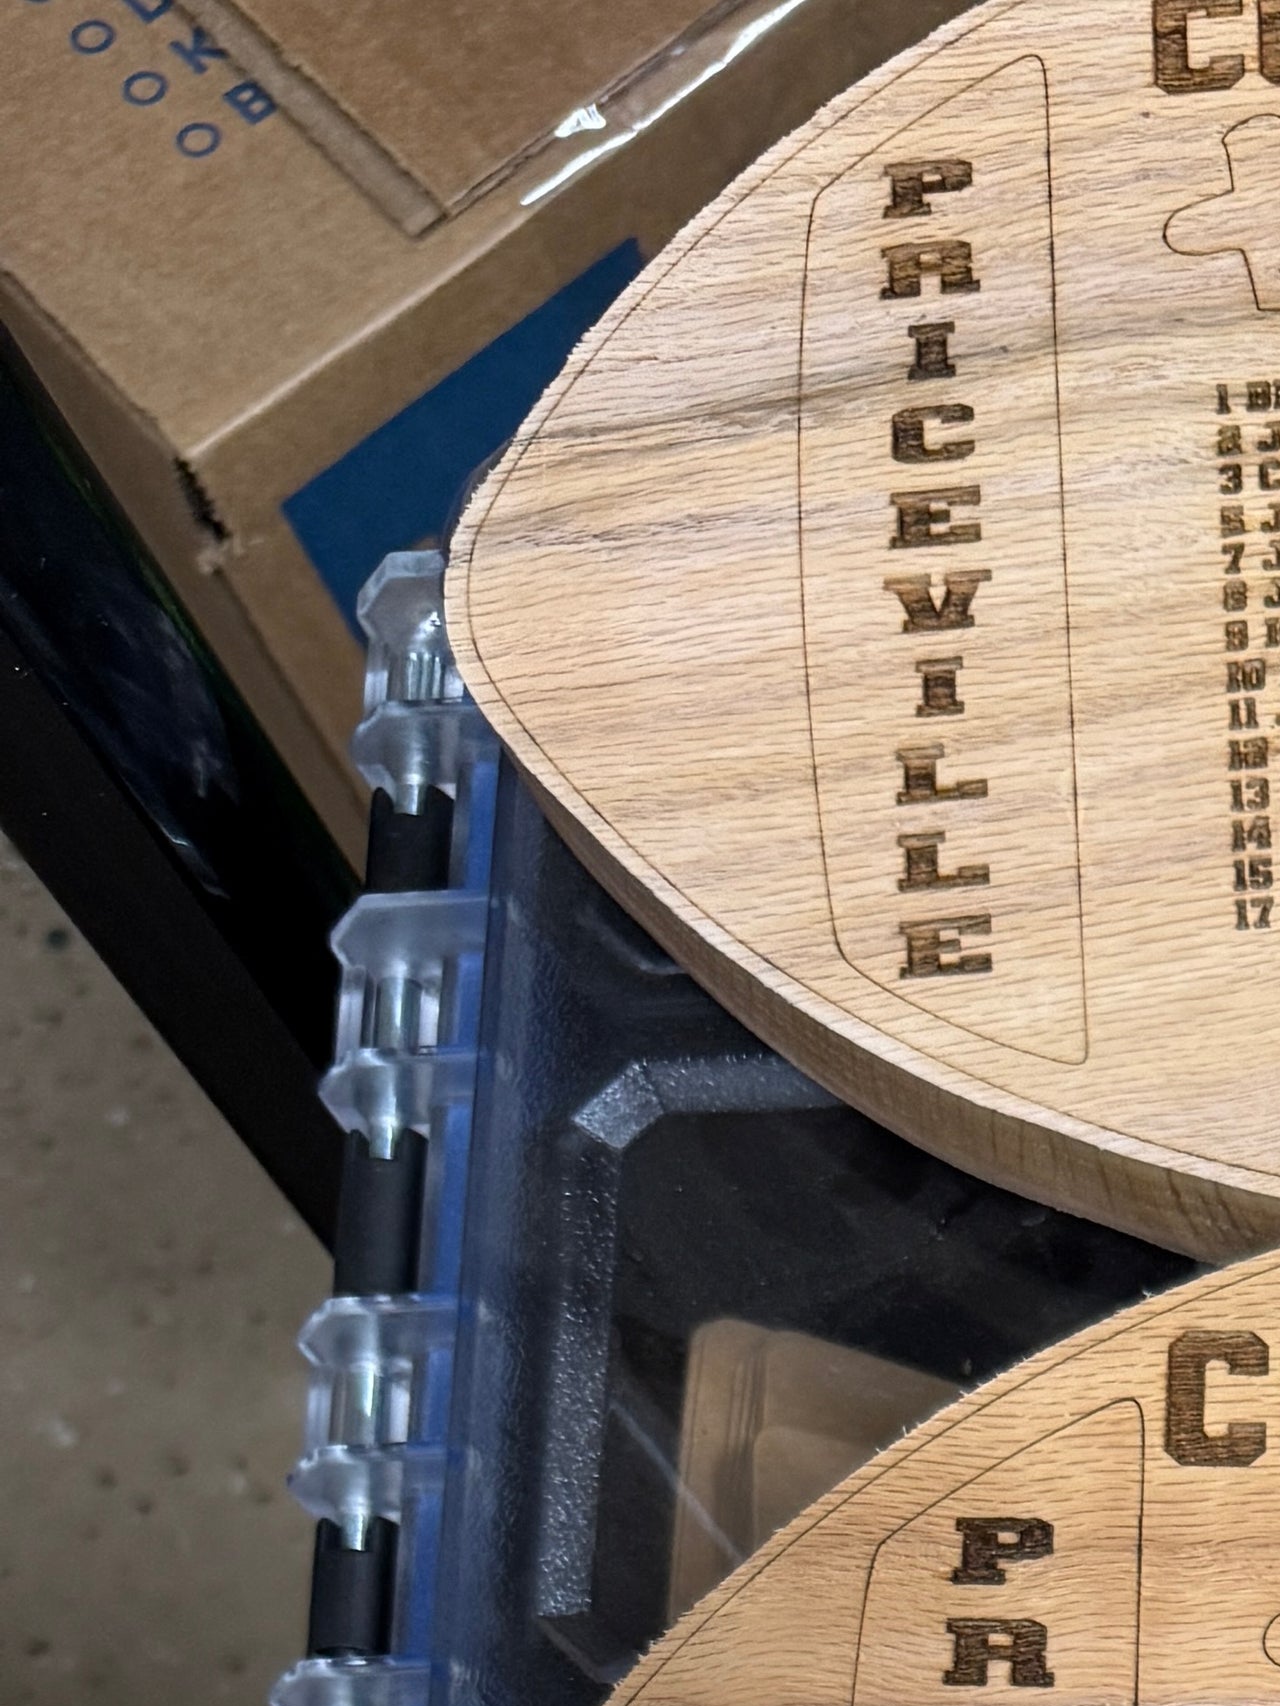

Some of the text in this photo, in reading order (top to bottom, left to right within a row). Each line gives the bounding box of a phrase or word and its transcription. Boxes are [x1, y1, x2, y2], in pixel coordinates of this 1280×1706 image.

[1219, 464, 1243, 493] 3
[879, 158, 993, 979] PRICEVILLE
[1235, 898, 1272, 929] 17
